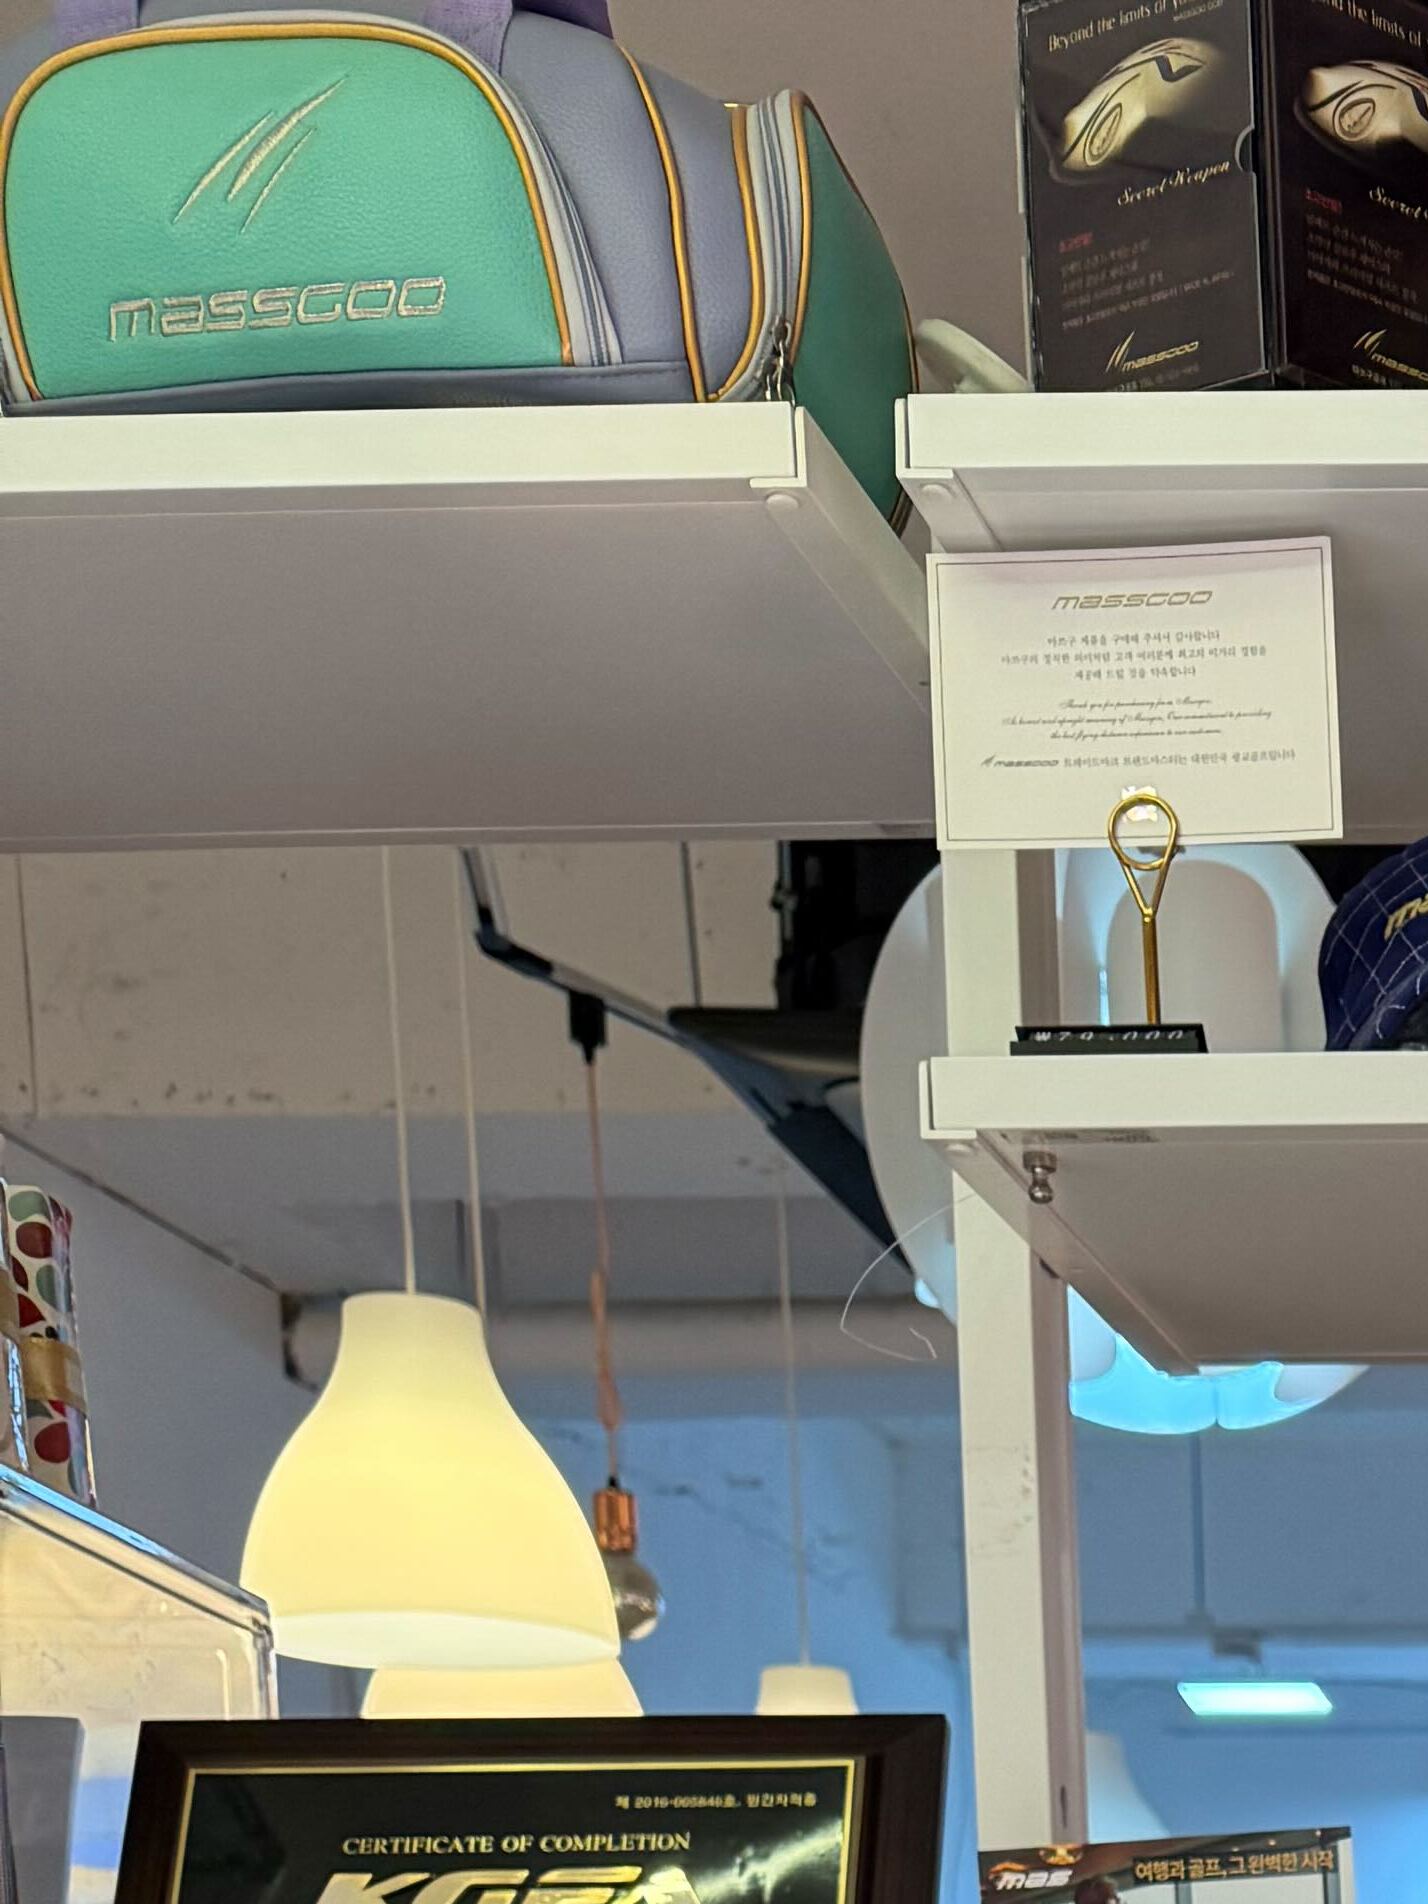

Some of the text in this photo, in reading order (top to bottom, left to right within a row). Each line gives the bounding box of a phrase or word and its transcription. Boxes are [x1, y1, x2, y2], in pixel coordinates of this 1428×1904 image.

[342, 1831, 692, 1856] CERTIFICATE OF COMPLETION
